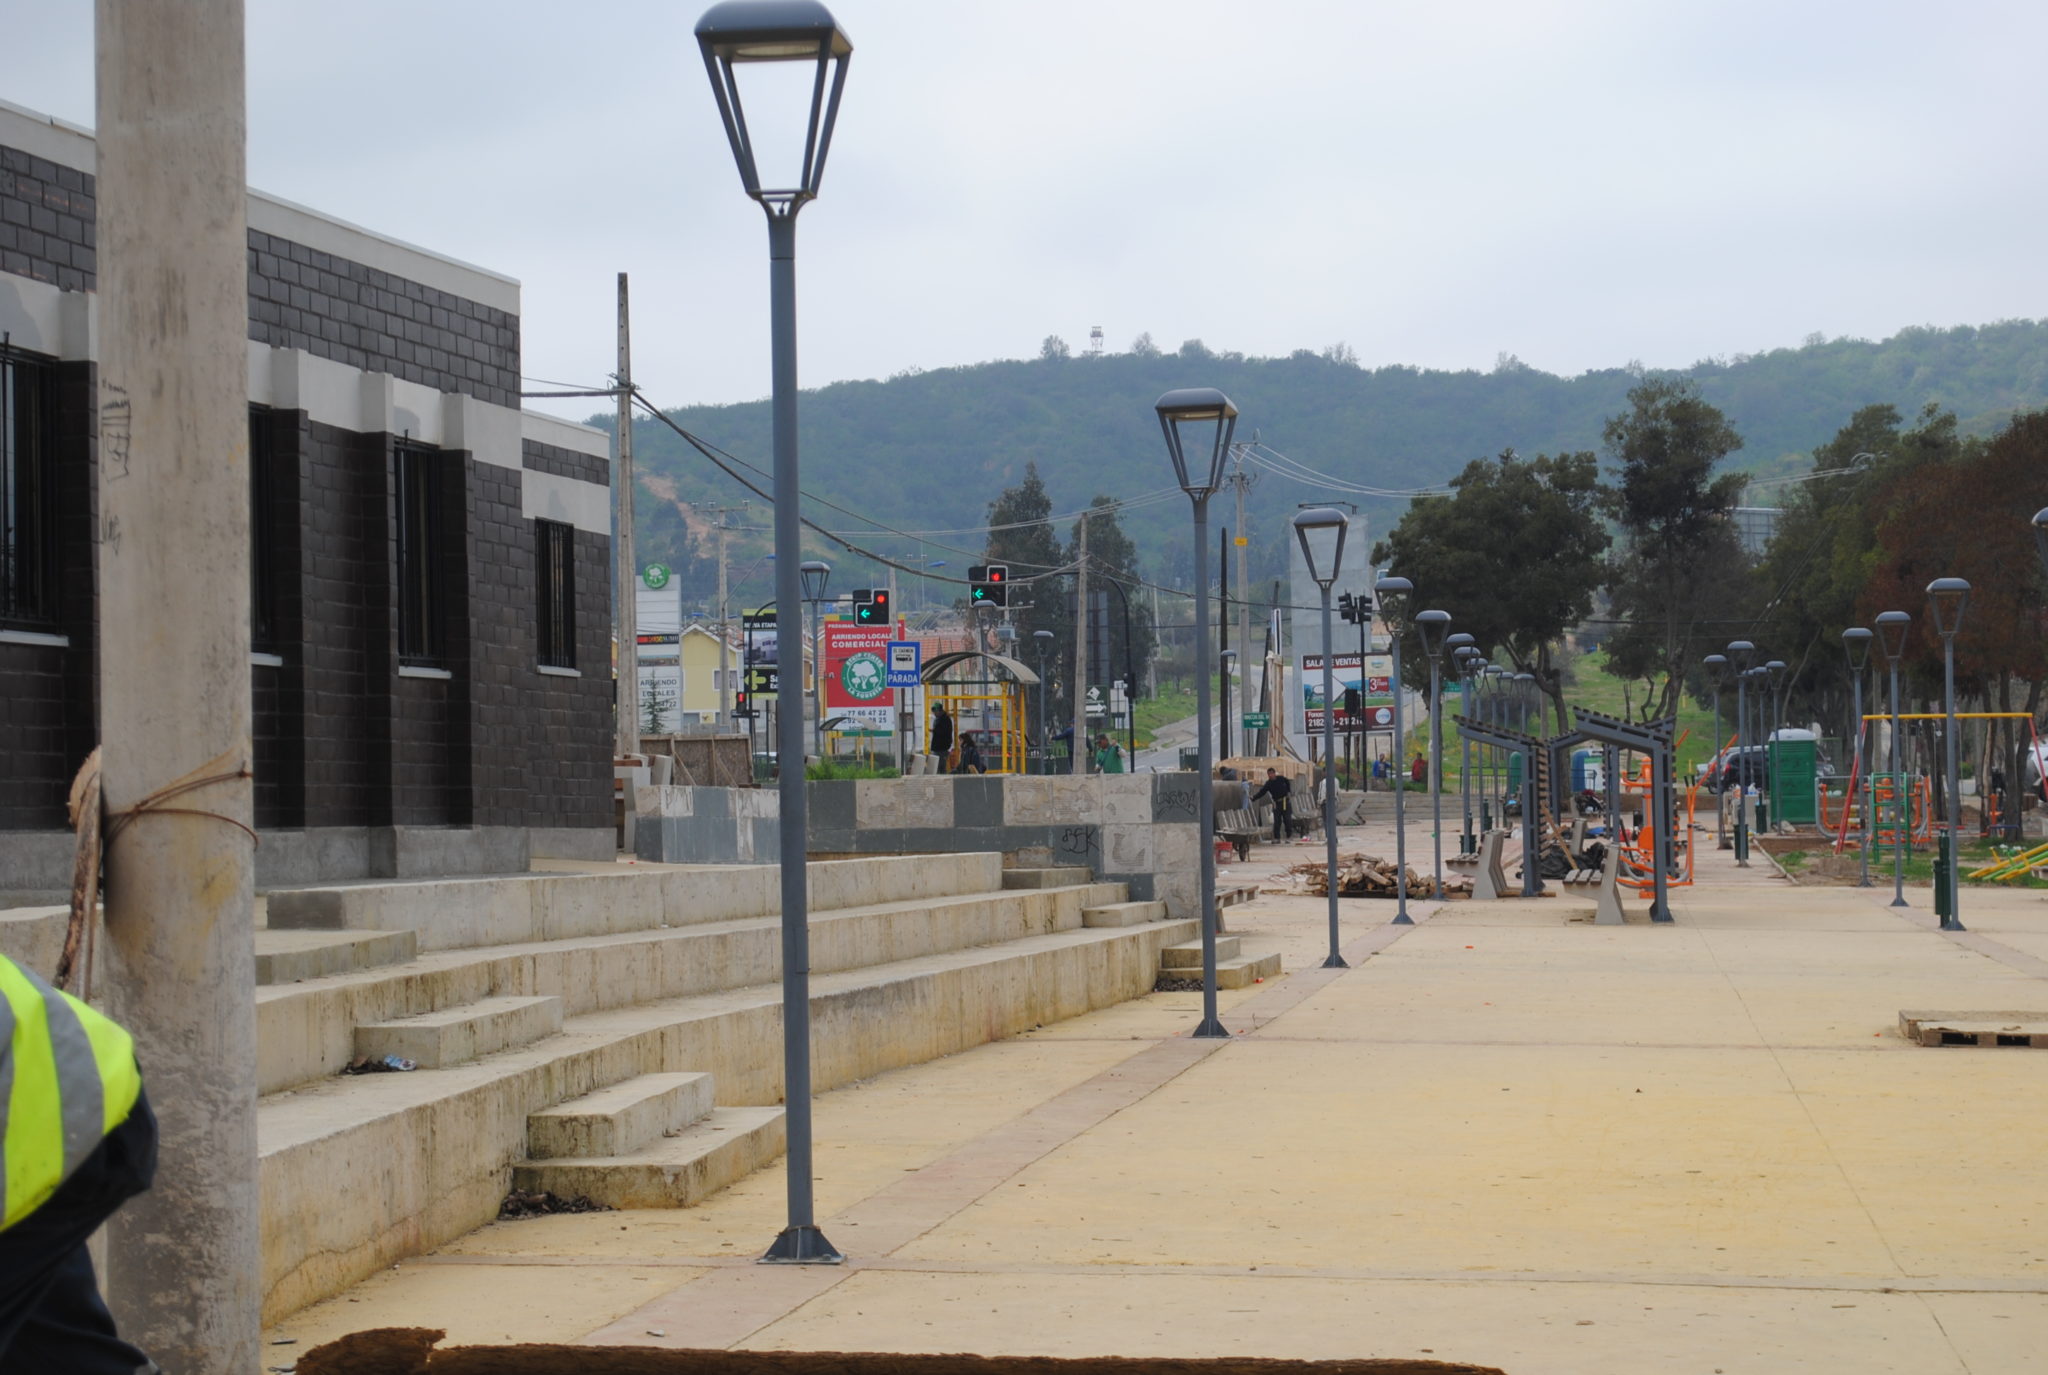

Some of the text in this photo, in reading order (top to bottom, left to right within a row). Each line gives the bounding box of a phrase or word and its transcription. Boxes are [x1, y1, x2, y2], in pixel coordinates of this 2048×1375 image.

[867, 632, 892, 640] LOCALE
[1335, 657, 1361, 665] VENTAS
[887, 674, 918, 683] PARADA
